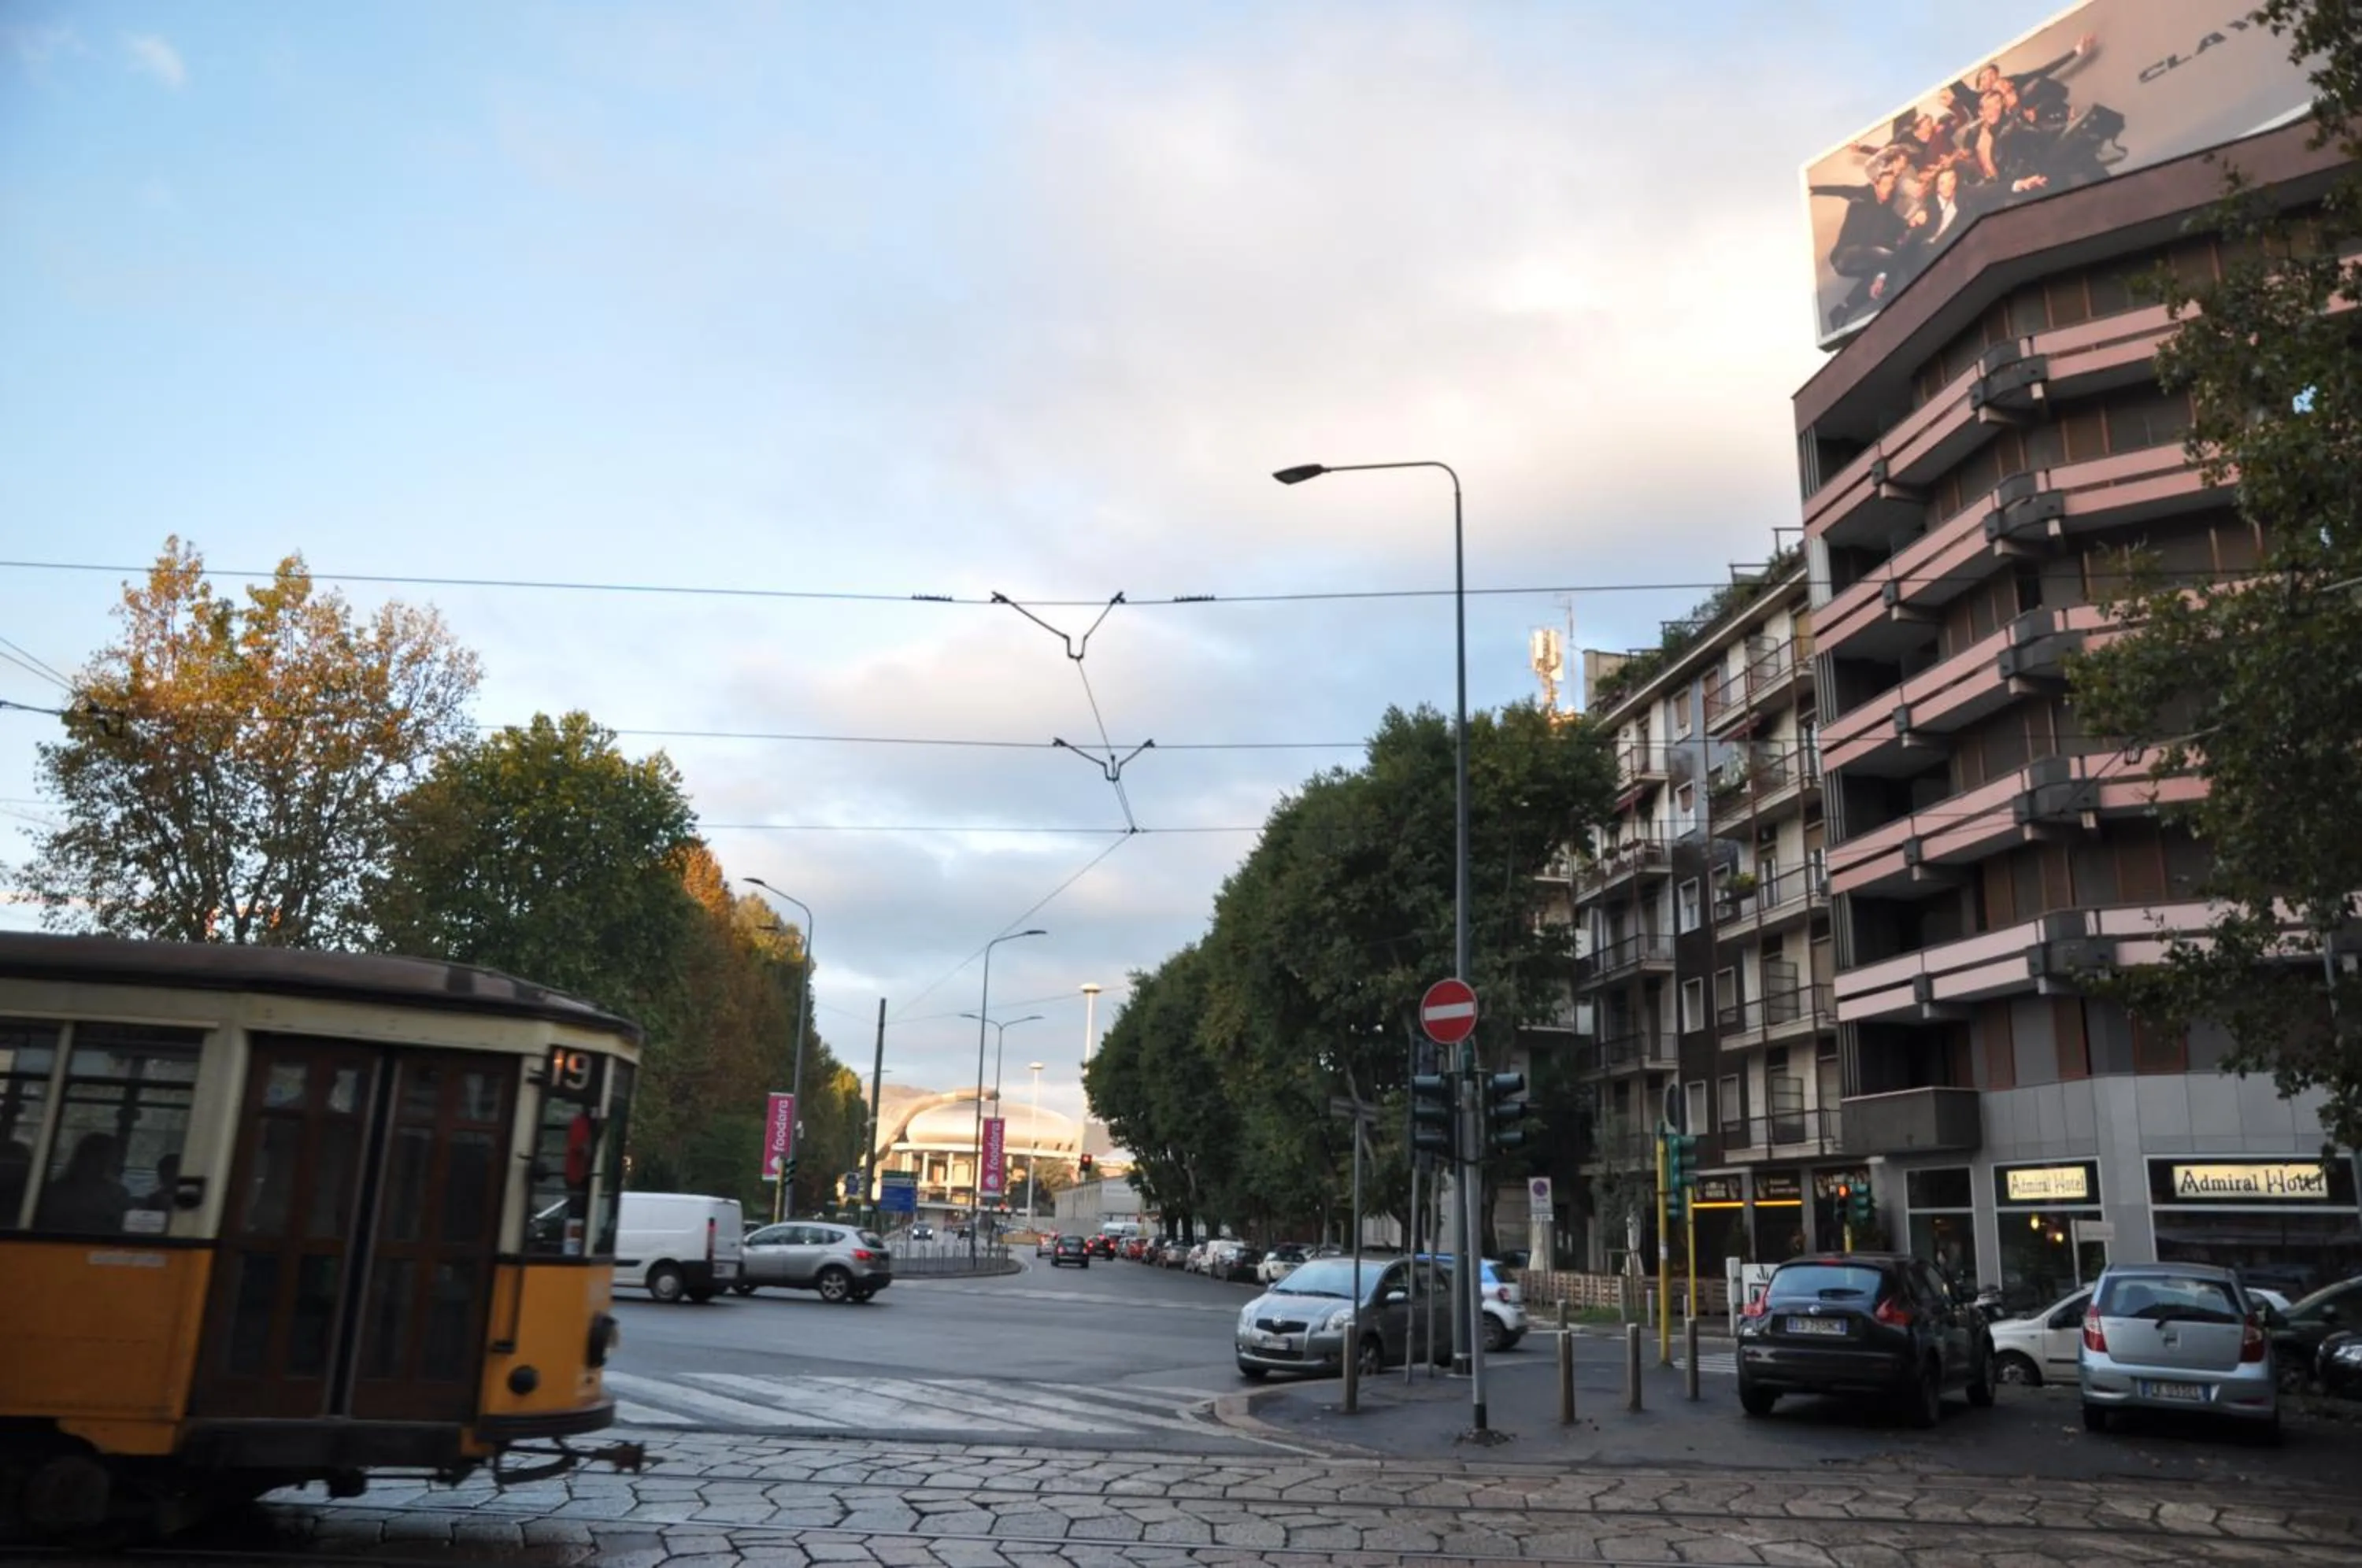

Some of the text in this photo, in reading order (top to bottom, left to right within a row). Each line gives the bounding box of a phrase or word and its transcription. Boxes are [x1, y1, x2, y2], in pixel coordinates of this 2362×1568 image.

[553, 1049, 592, 1089] 19
[772, 1100, 788, 1152] foodora
[986, 1121, 1001, 1170] foodora
[2012, 1171, 2085, 1195] Admiral Hotel
[2180, 1169, 2323, 1193] Admiral Hotel
